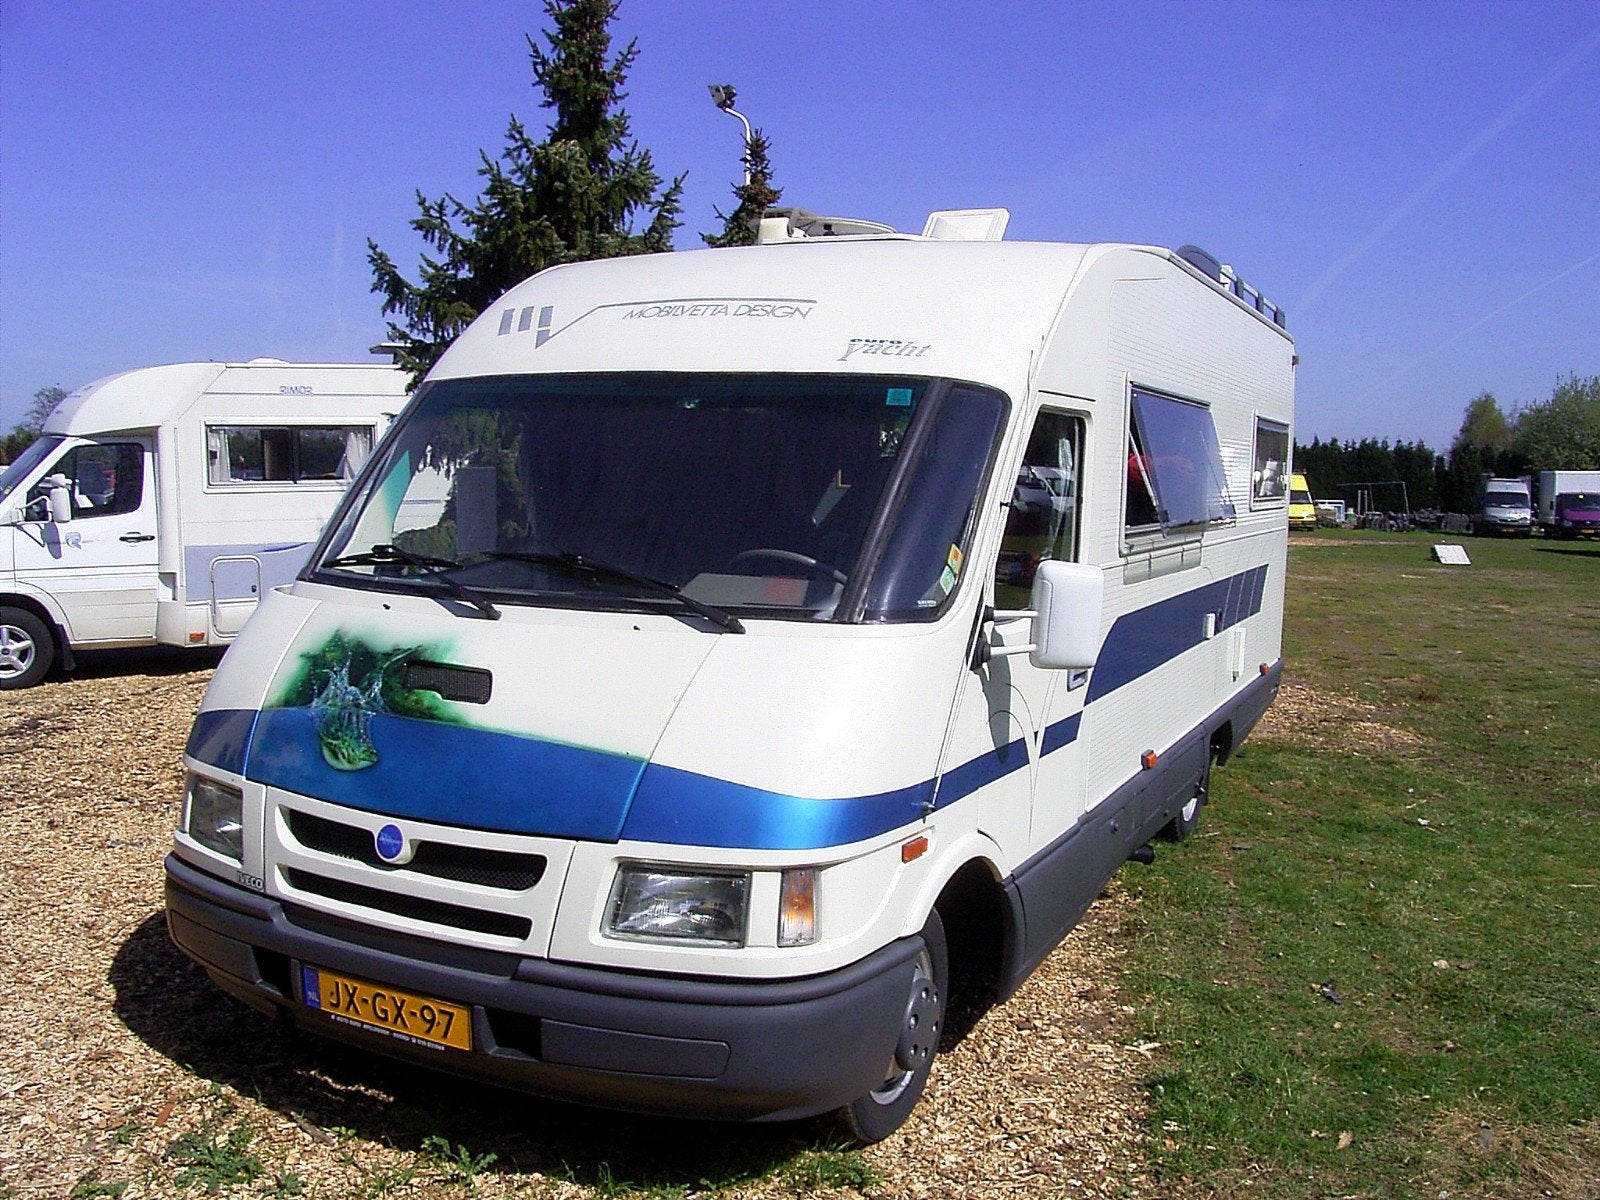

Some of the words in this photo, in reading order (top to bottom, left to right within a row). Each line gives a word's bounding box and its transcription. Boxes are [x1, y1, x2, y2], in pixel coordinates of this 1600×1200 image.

[622, 304, 730, 321] MOBILVETTA
[732, 304, 813, 320] DESIGN
[280, 385, 313, 396] RIMOR
[238, 871, 264, 890] IVECO
[329, 979, 455, 1039] JX-GX-97
